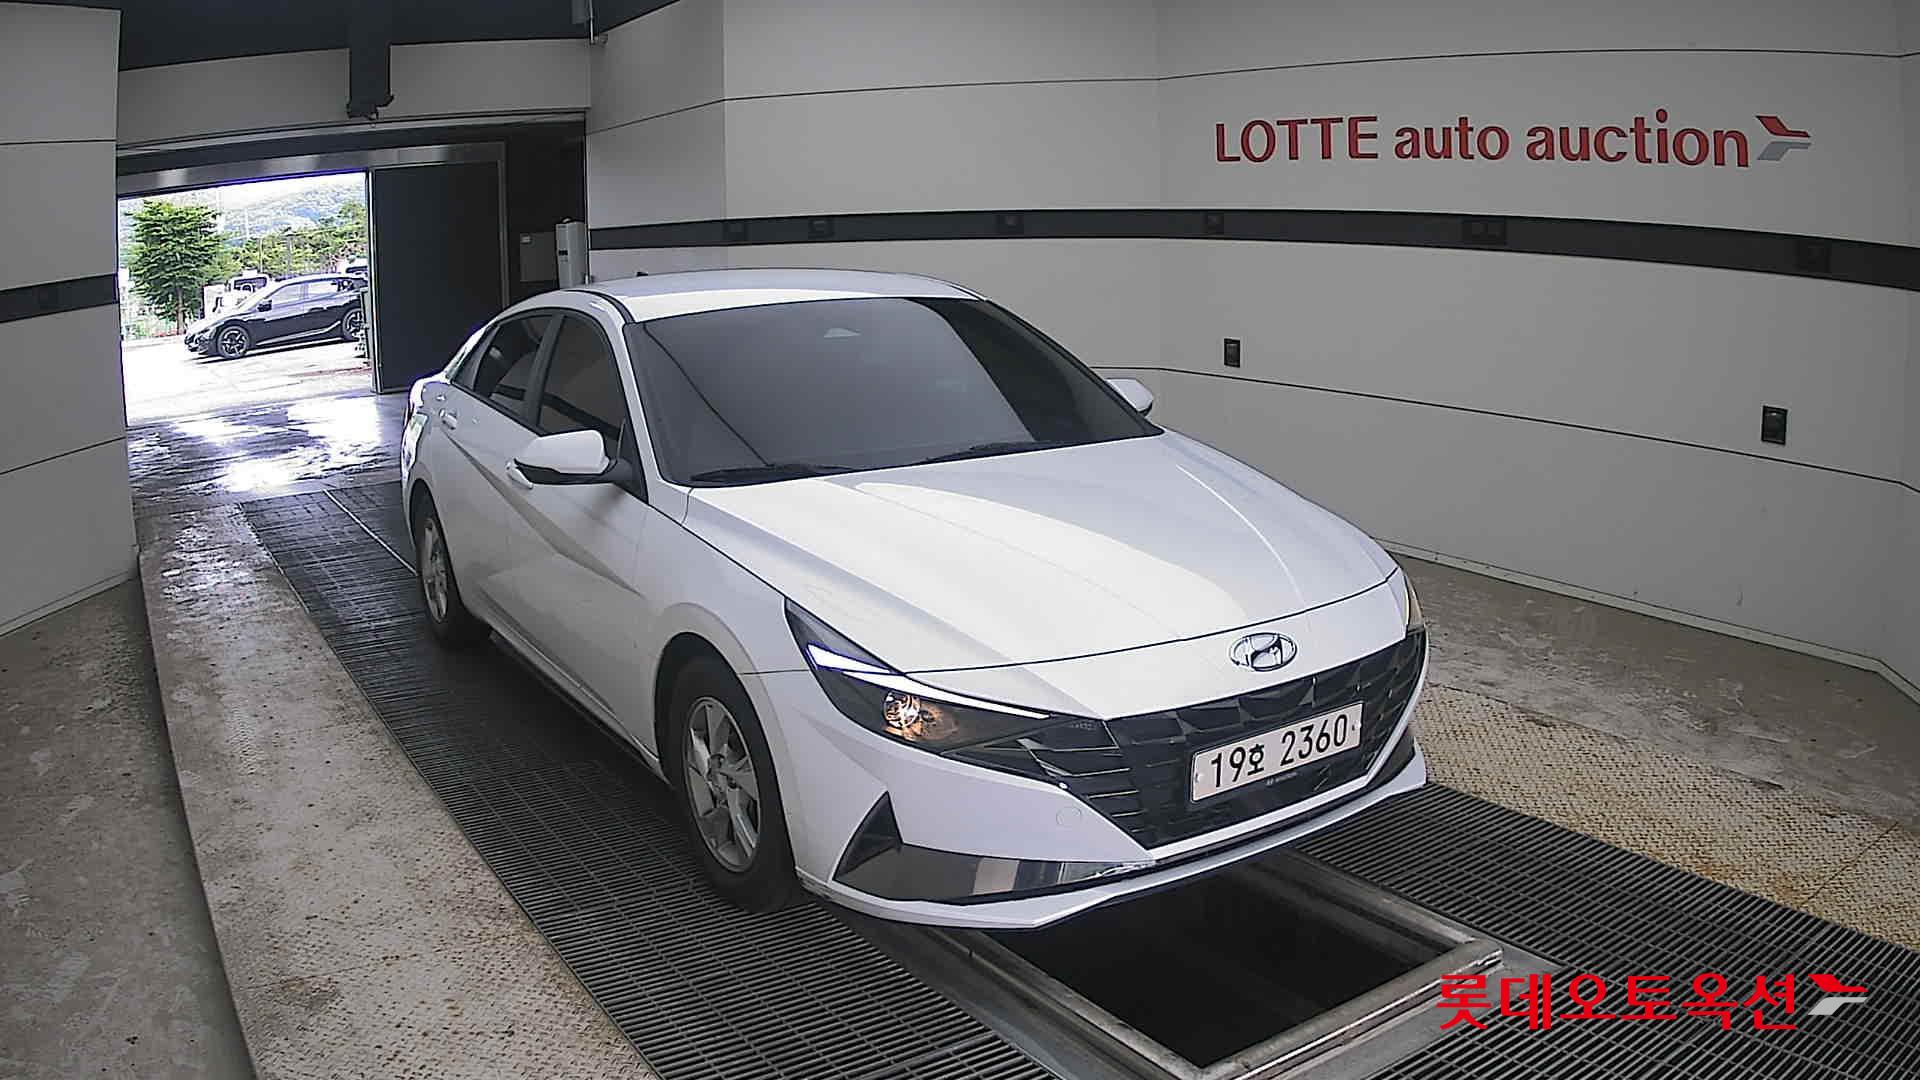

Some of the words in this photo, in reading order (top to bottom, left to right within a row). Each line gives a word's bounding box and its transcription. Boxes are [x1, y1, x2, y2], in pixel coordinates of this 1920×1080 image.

[1216, 116, 1378, 162] LOTTE
[1394, 116, 1510, 161] auto
[1526, 109, 1750, 168] auction
[1211, 743, 1265, 788] 19호
[1280, 714, 1348, 767] 2360
